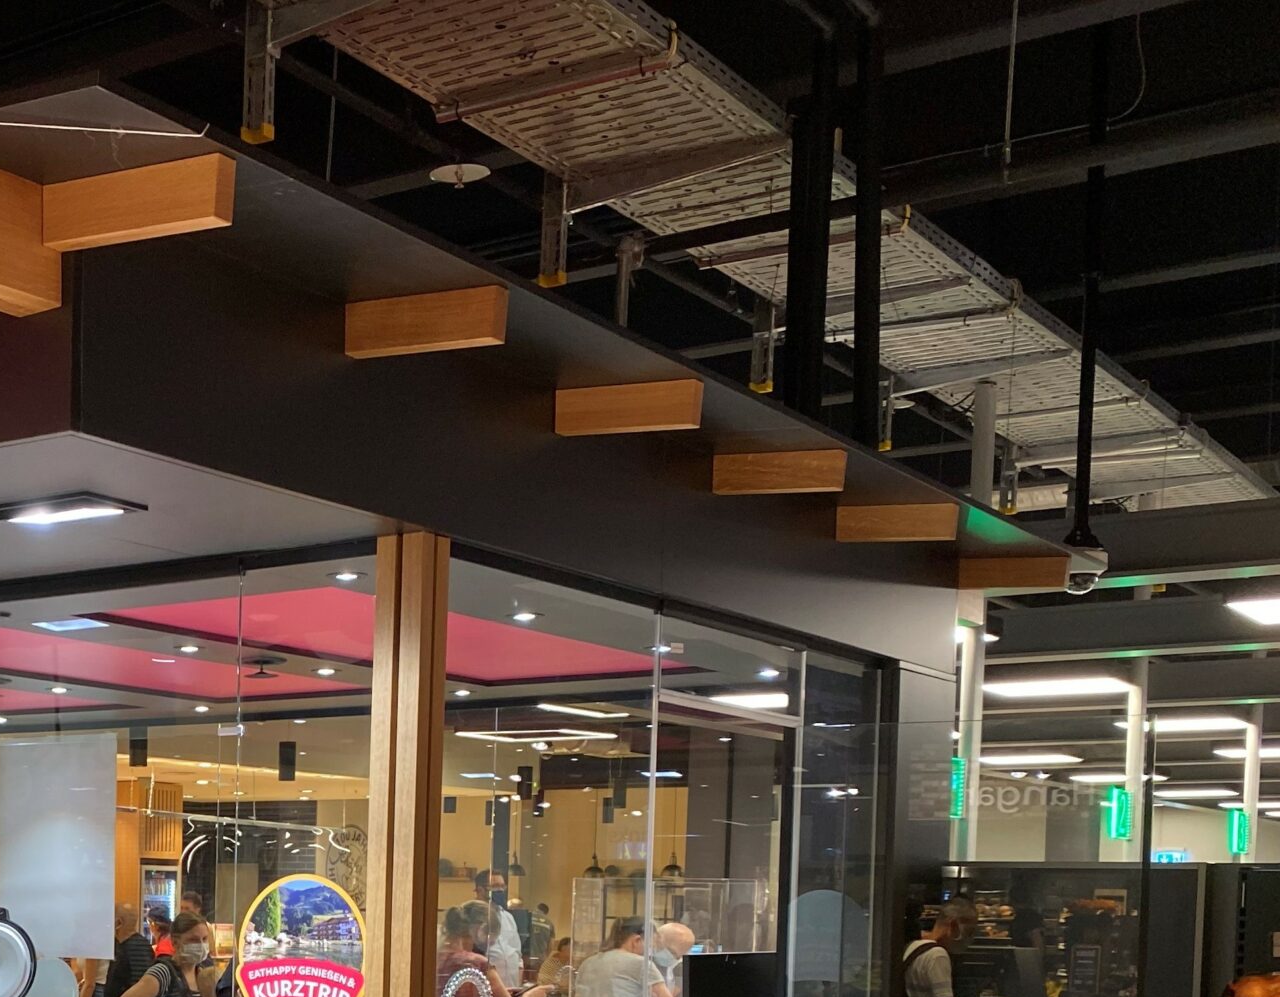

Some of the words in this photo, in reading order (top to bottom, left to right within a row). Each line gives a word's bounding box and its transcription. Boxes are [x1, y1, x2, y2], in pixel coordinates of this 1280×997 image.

[248, 966, 296, 980] EATHAPPY
[298, 966, 347, 984] GENIEßEN
[347, 977, 356, 989] &
